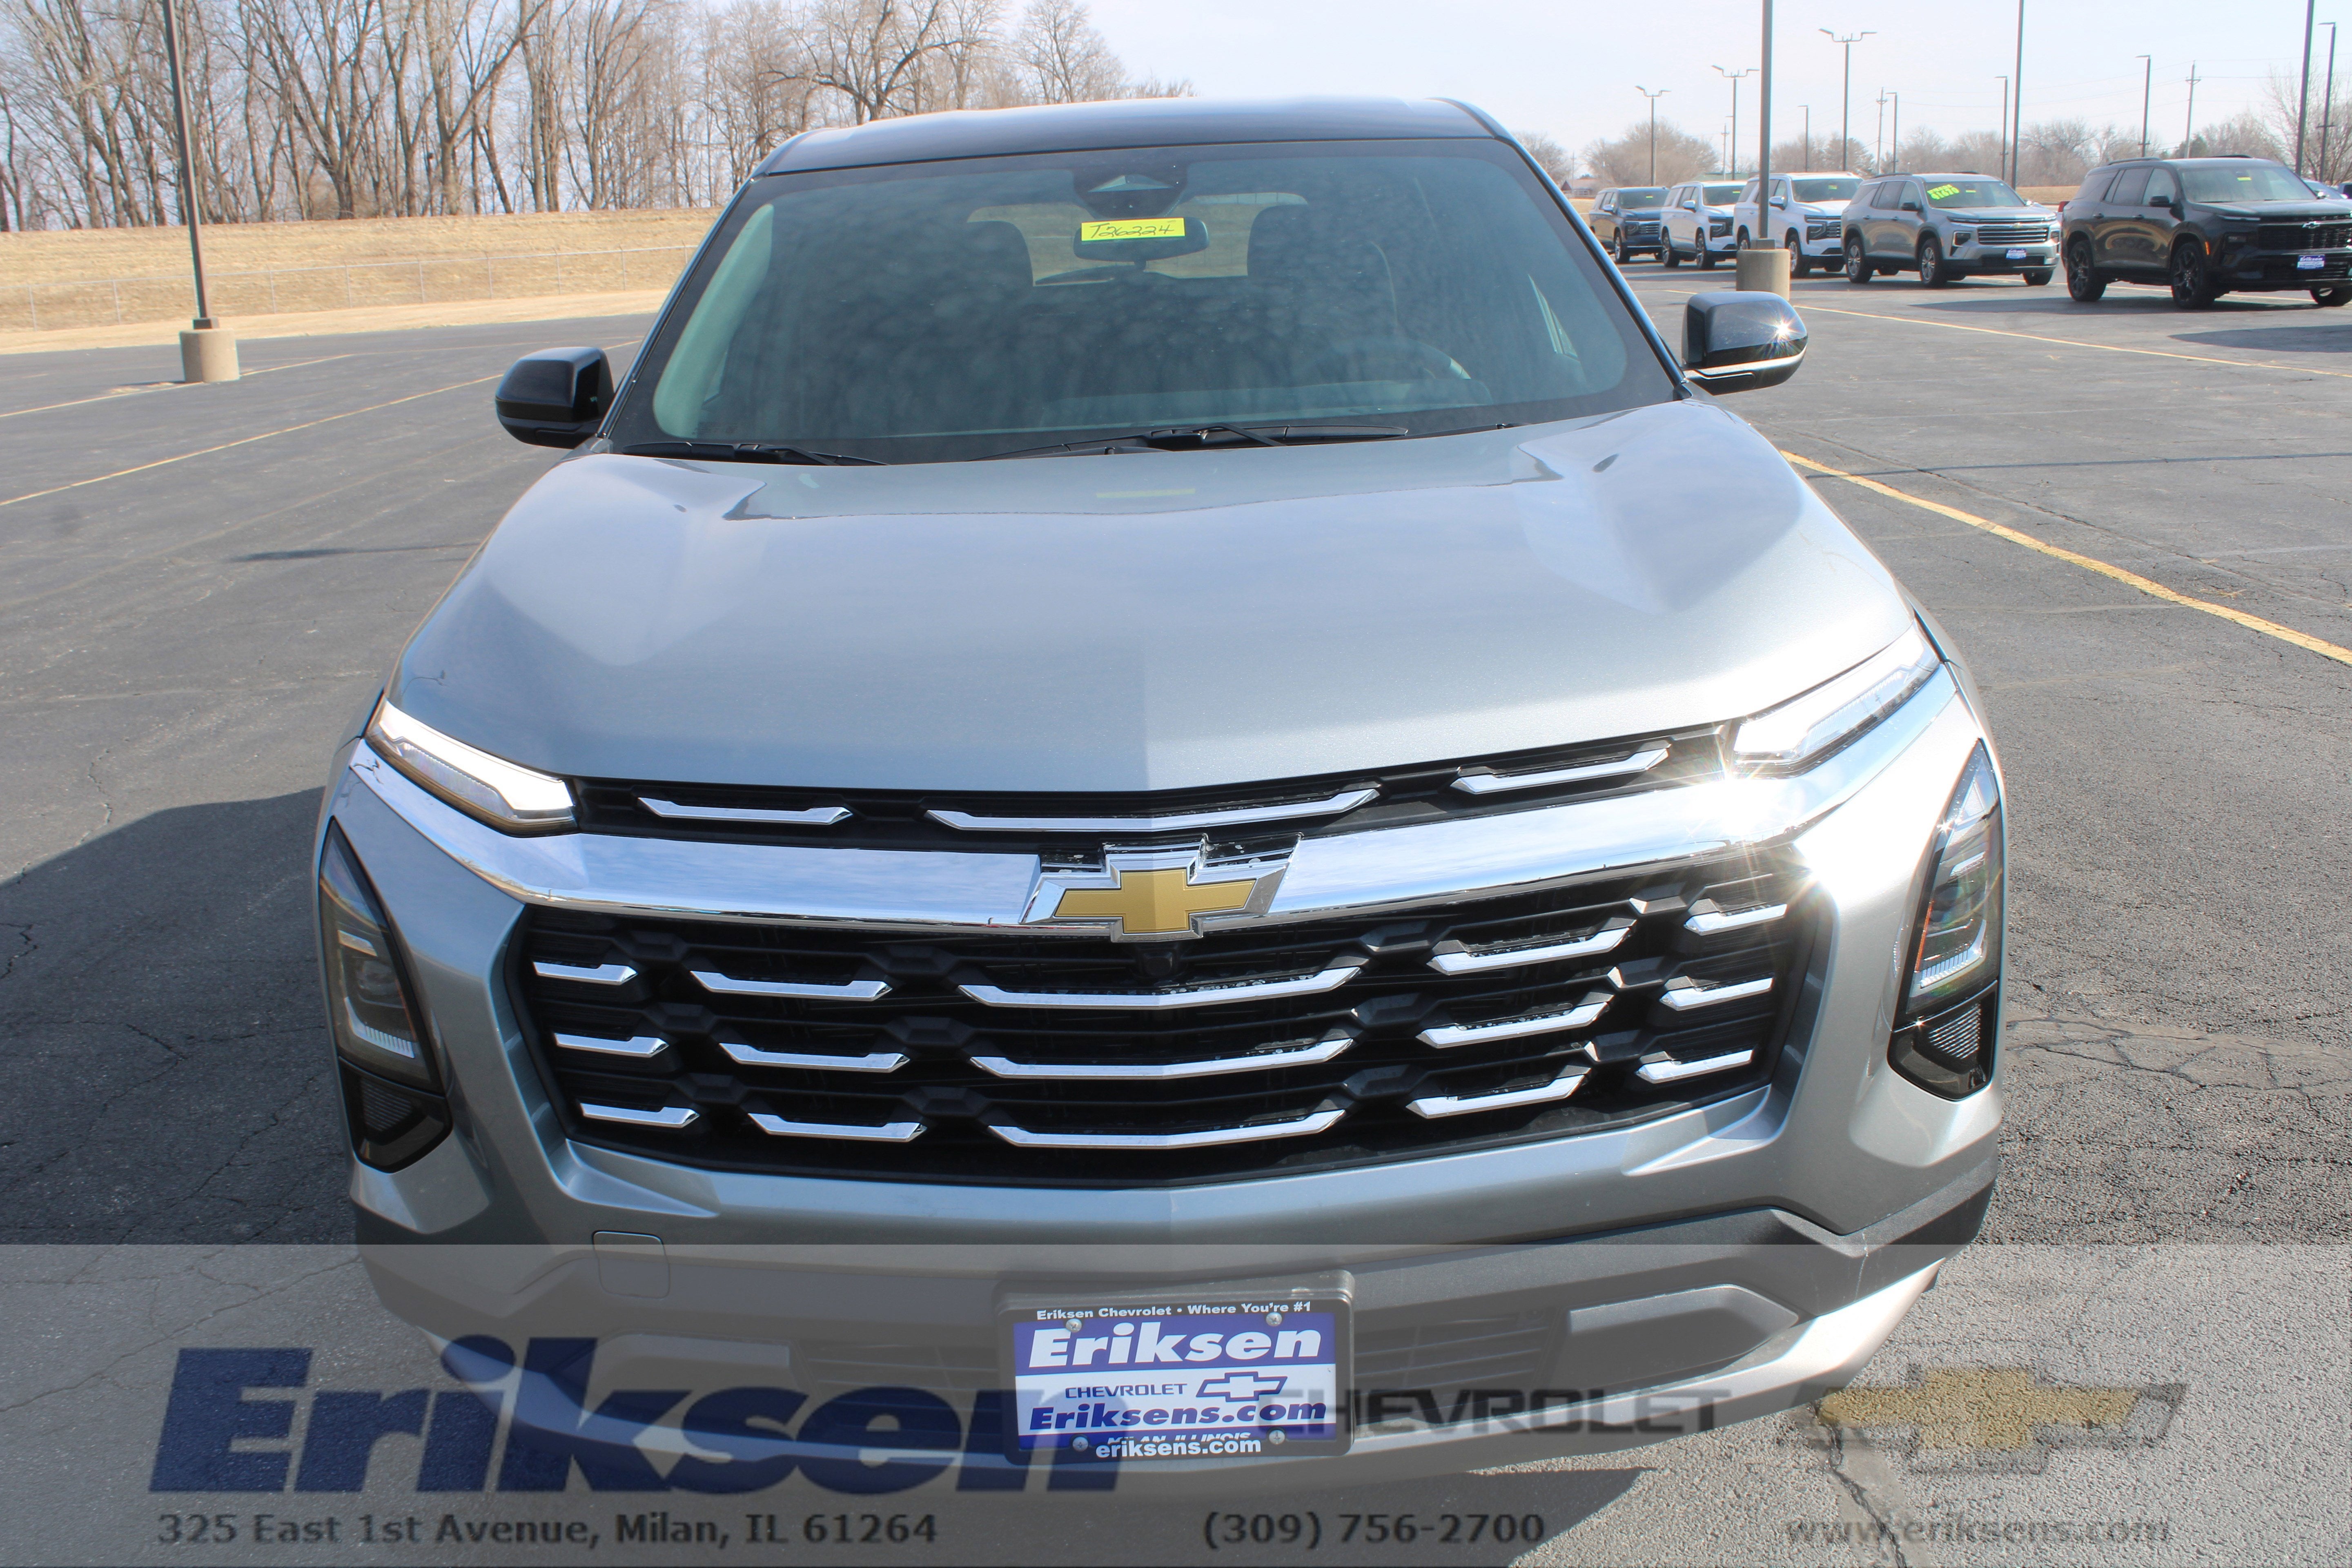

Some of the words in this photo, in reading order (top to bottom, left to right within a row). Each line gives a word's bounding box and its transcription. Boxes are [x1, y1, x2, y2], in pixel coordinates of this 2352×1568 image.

[1090, 223, 1174, 238] T26224
[1036, 1309, 1094, 1320] Eriksen
[1098, 1306, 1172, 1317] Chevrolet
[1187, 1304, 1236, 1314] Where
[1241, 1302, 1289, 1313] You're
[1293, 1301, 1310, 1312] #1
[1029, 1321, 1322, 1368] Eriksen
[1065, 1383, 1188, 1399] CHEVROLET
[1029, 1402, 1327, 1430] Eriksens.com
[1096, 1439, 1261, 1458] eriksens.com
